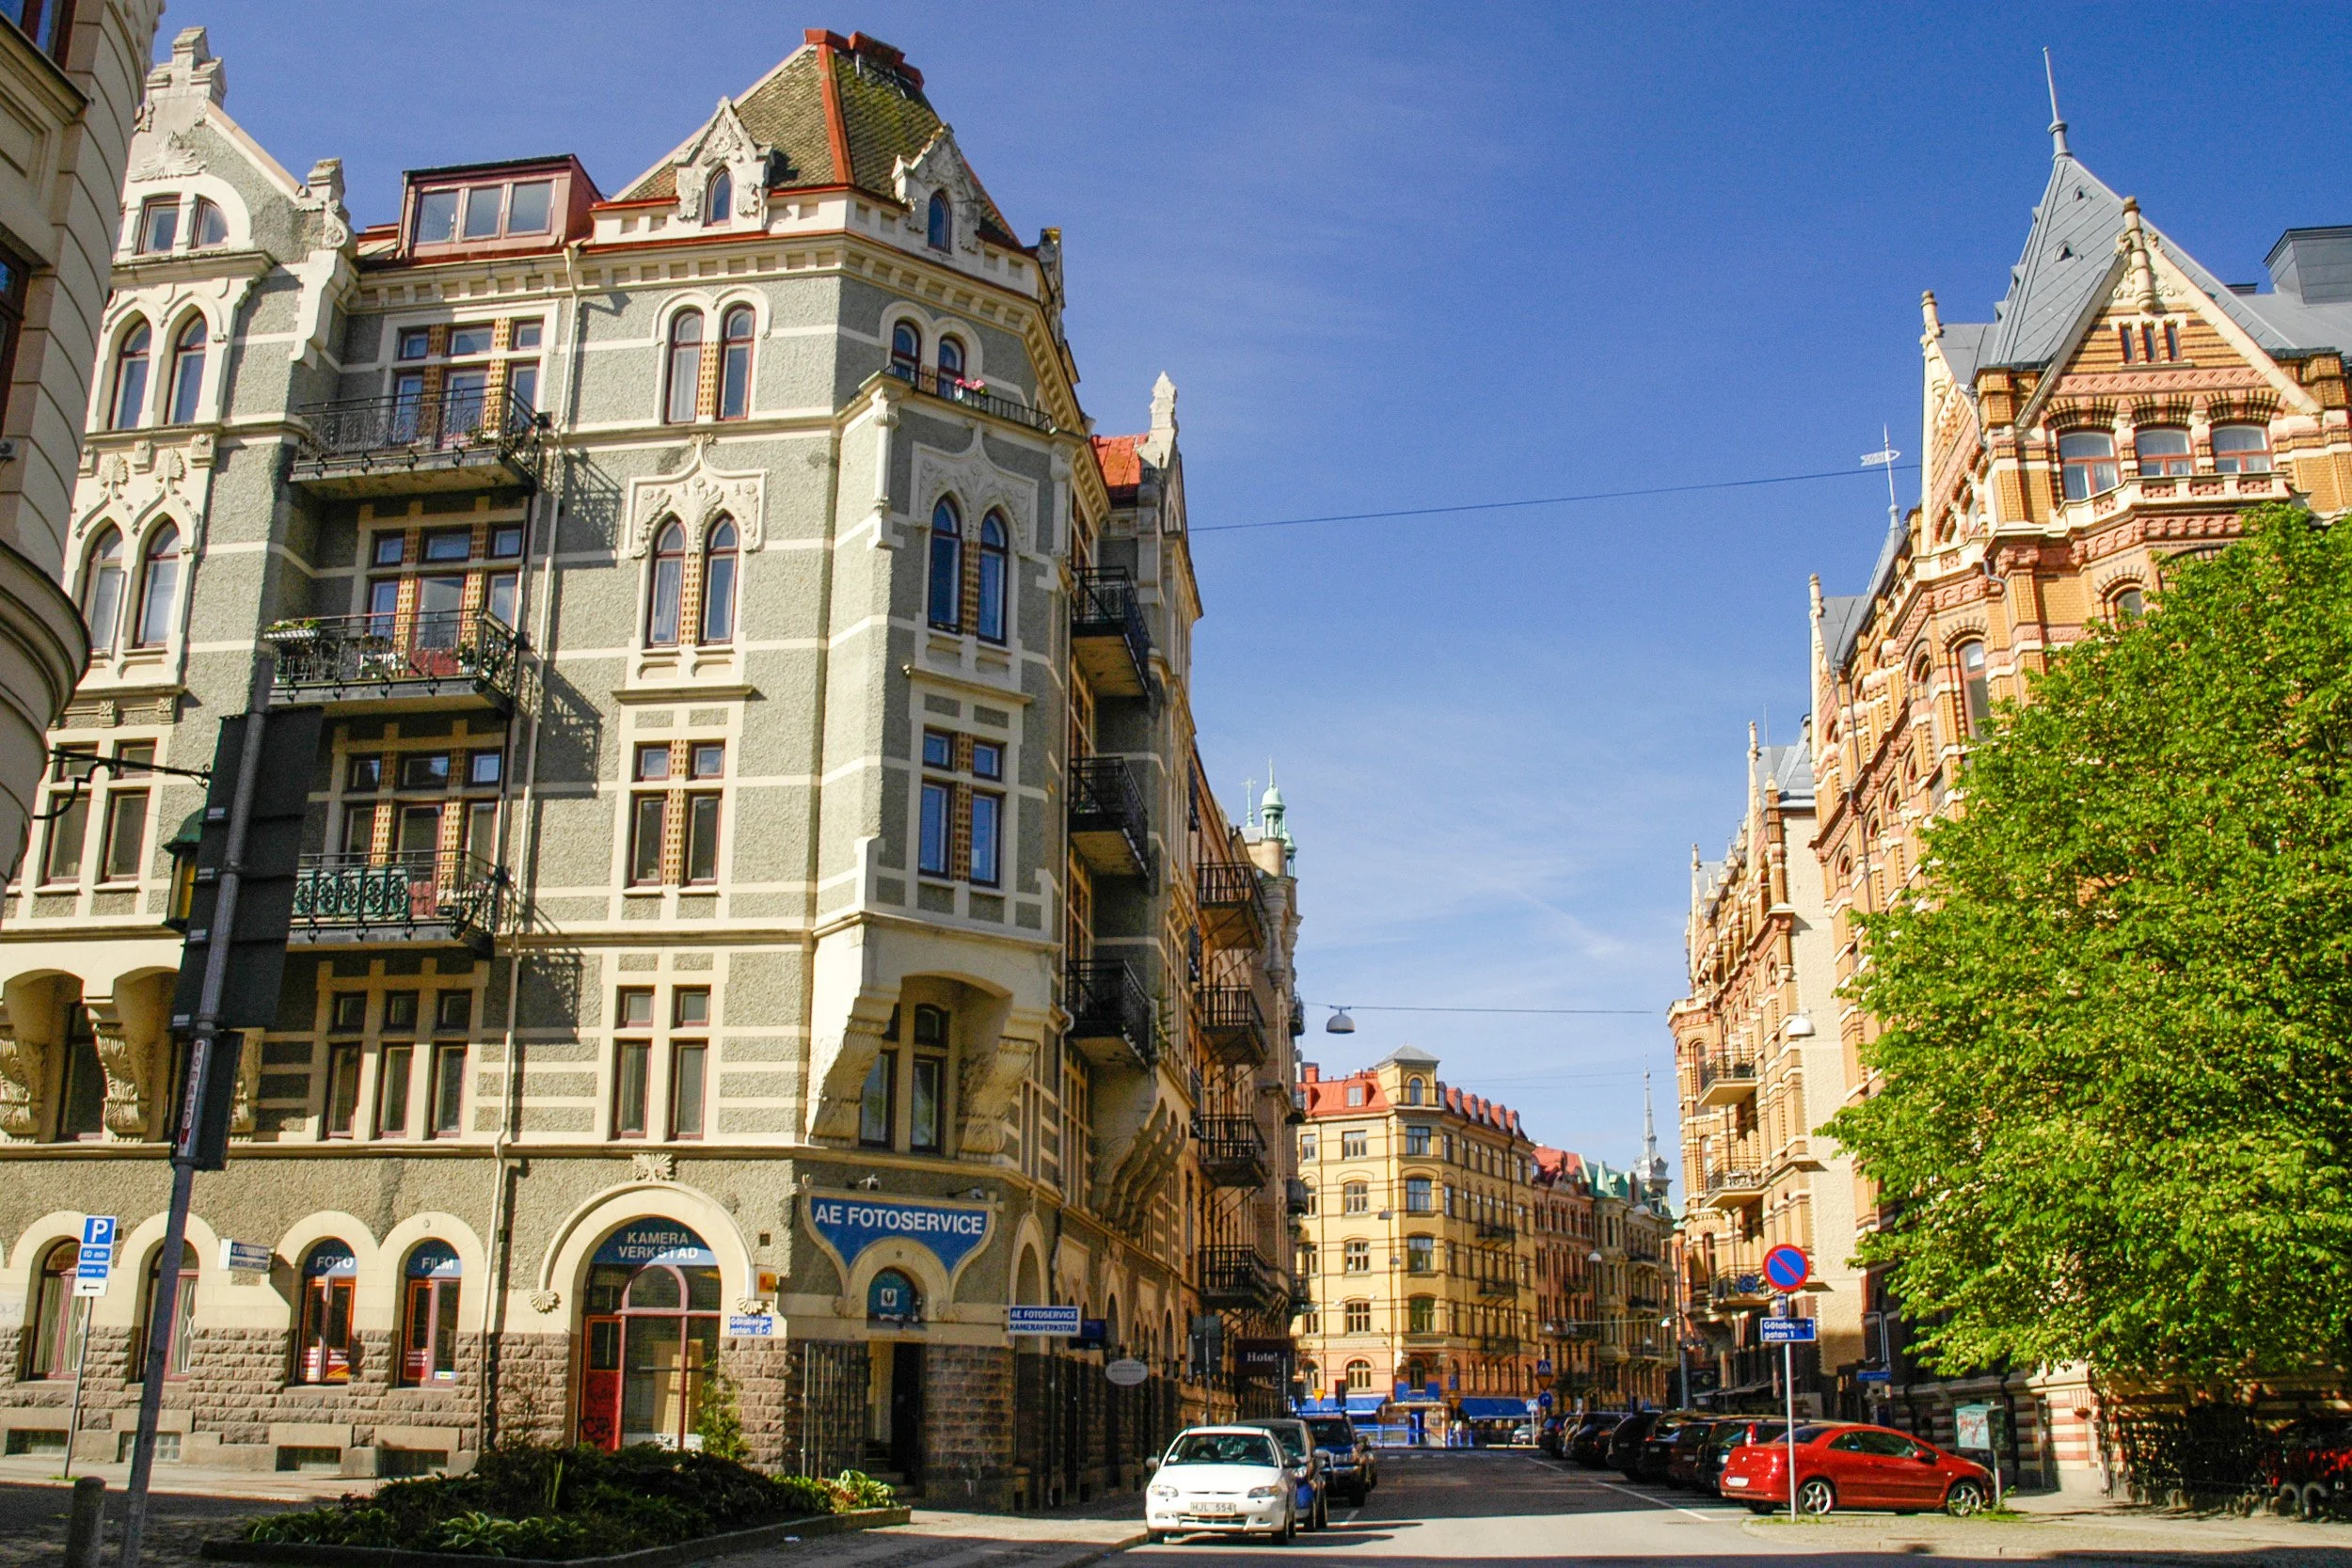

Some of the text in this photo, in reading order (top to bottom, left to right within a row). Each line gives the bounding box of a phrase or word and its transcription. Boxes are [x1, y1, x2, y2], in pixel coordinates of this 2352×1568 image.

[815, 1204, 983, 1234] AE FOTOSERVICE
[91, 1219, 108, 1243] P
[628, 1232, 689, 1244] KAMERA
[618, 1246, 699, 1259] VERKSTAD
[316, 1256, 355, 1269] FOTO
[421, 1257, 454, 1271] FILM
[1011, 1309, 1076, 1320] AE FOTOSERVICE
[1009, 1323, 1077, 1332] KAMERAVERKSTAD
[1764, 1331, 1788, 1340] gatan
